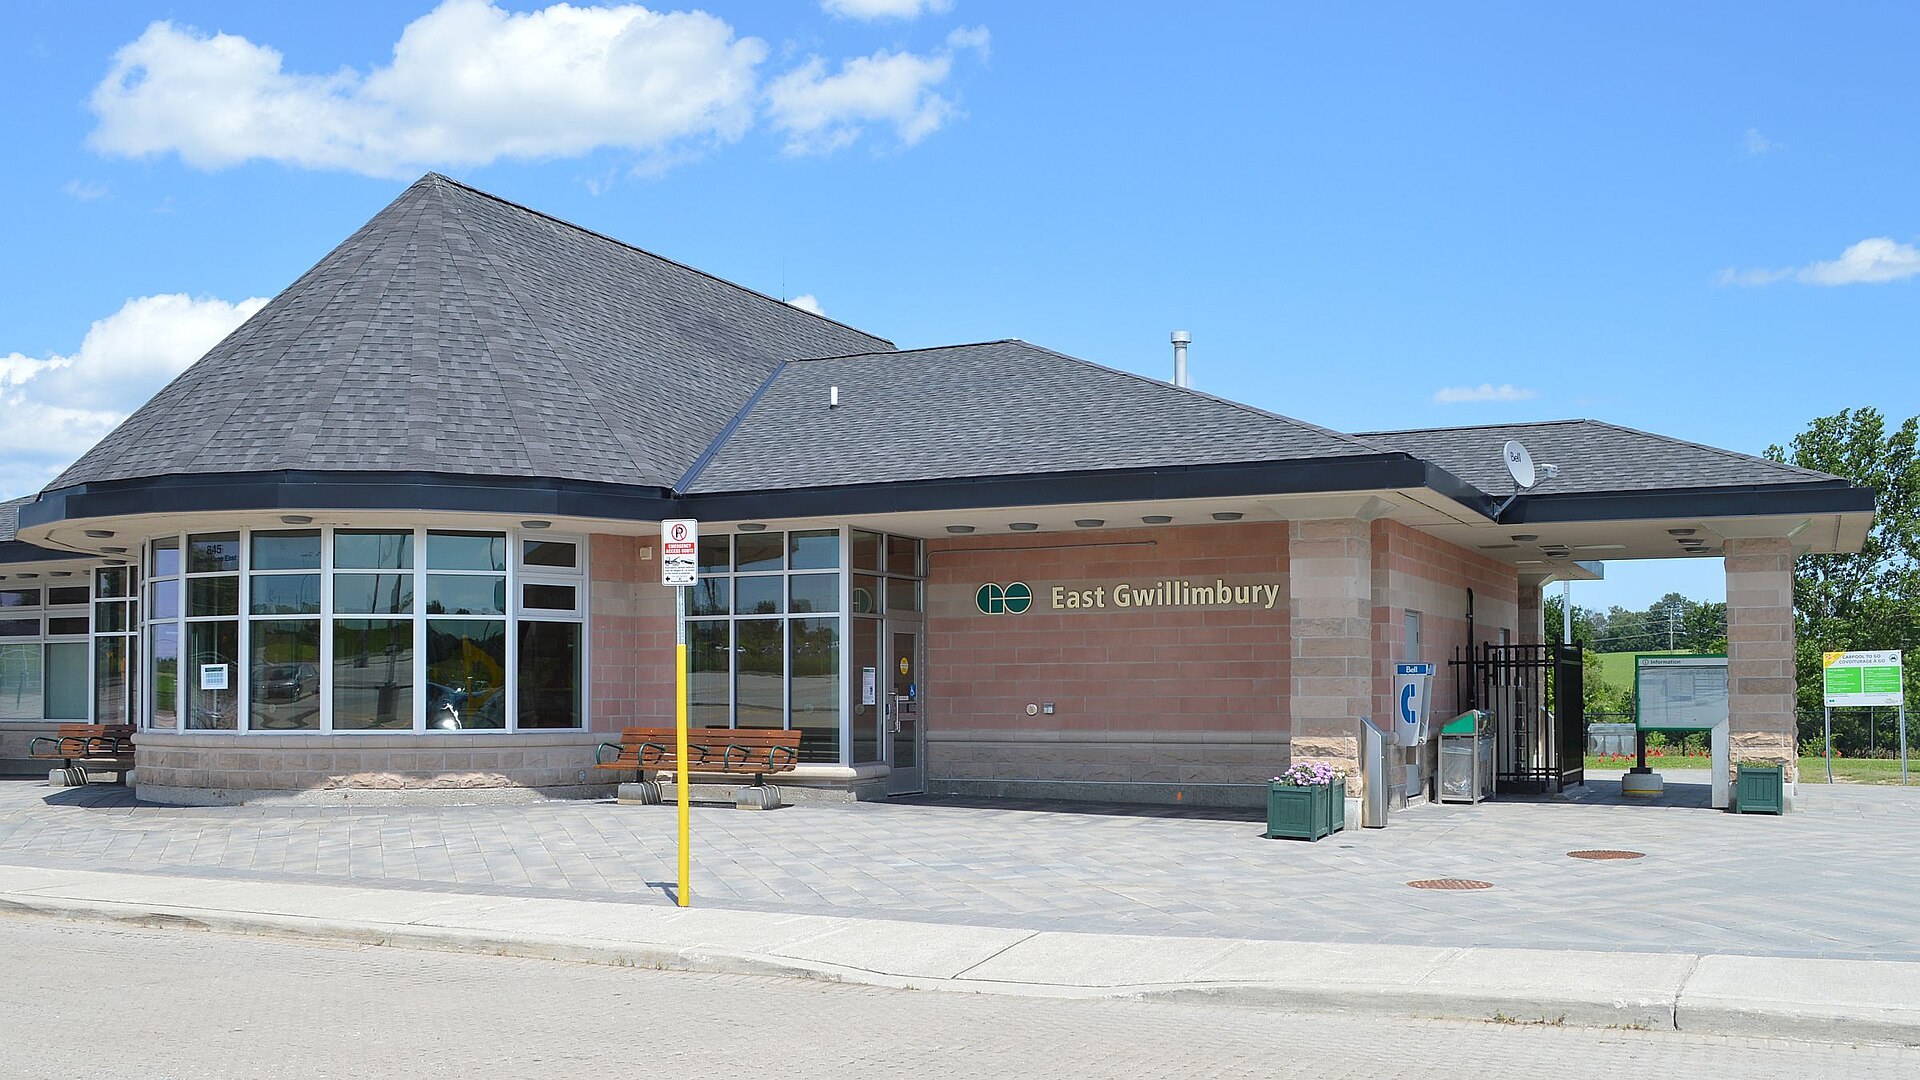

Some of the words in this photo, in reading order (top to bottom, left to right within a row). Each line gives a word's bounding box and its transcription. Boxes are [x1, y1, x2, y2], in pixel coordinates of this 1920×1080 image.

[1510, 451, 1522, 463] Bell
[206, 544, 222, 555] 845
[224, 554, 237, 562] East
[1051, 586, 1105, 609] East
[1113, 580, 1280, 609] Gwillimbury
[1406, 666, 1418, 674] Bell
